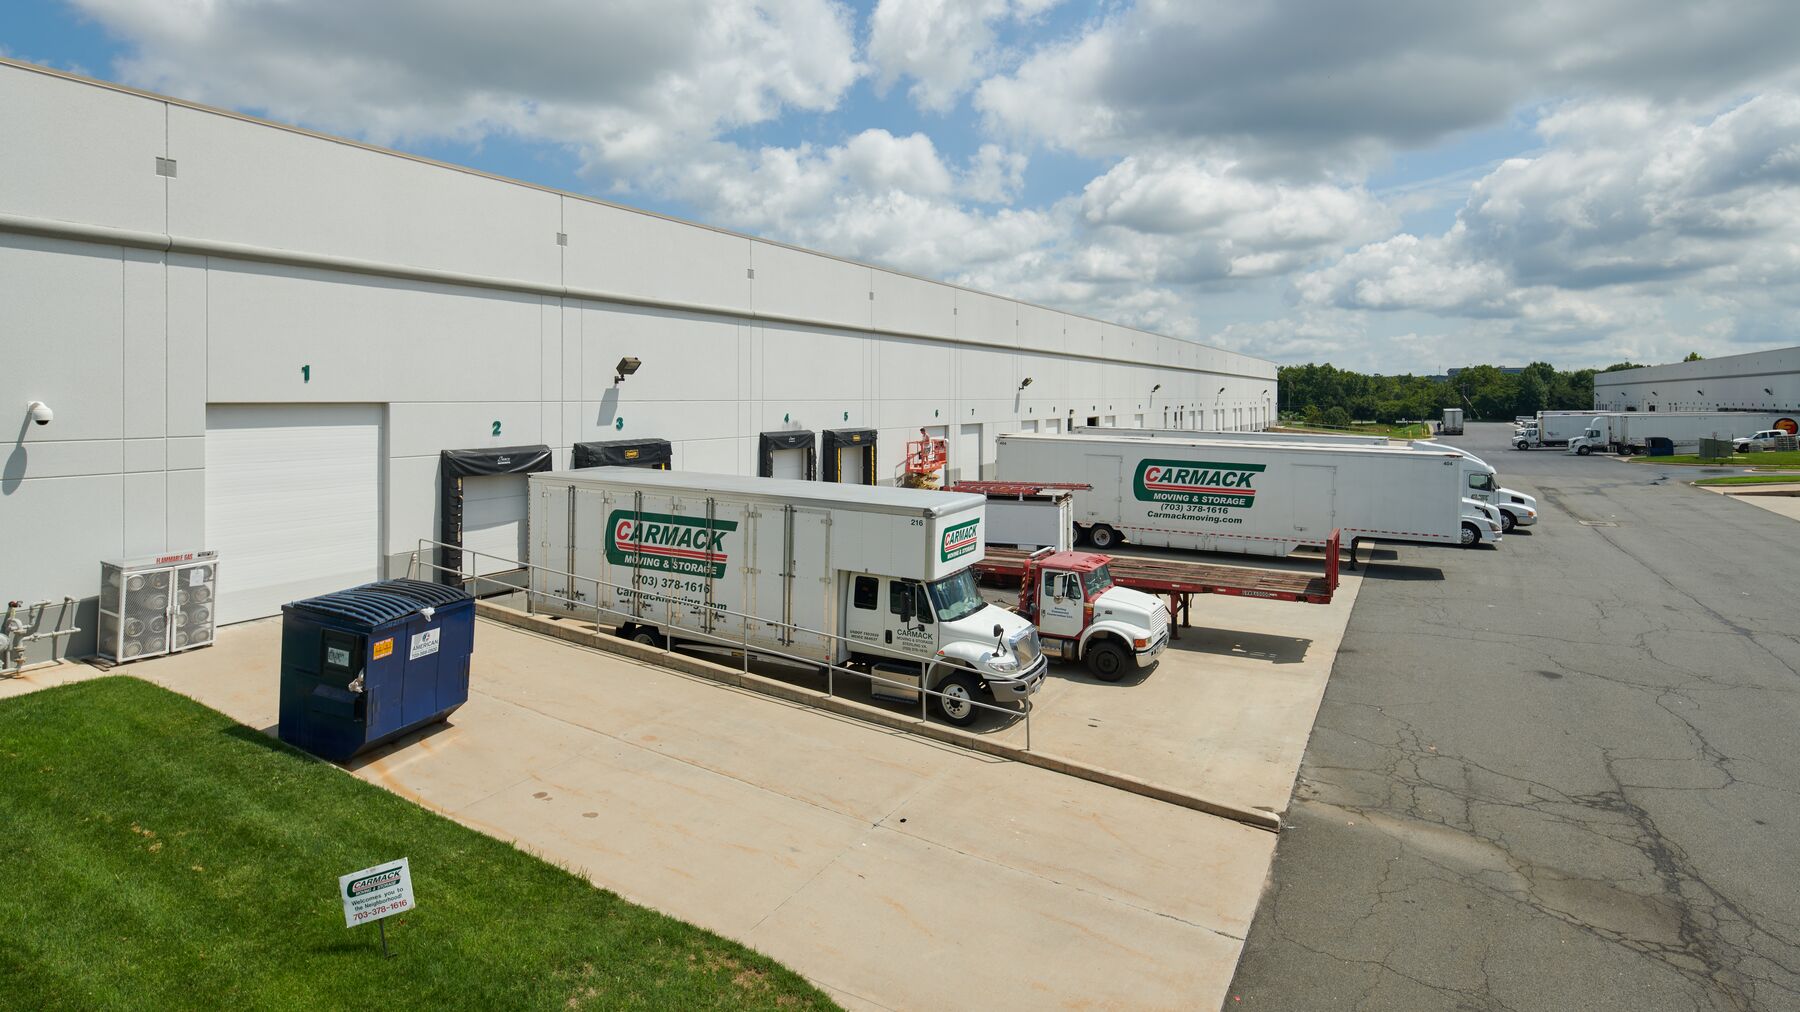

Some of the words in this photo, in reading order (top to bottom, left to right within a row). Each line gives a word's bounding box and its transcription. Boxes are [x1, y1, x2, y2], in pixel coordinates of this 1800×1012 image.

[301, 364, 310, 383] 1
[615, 417, 624, 430] 3
[784, 413, 790, 423] 4
[843, 411, 849, 421] 5
[492, 421, 502, 436] 2
[1145, 467, 1256, 488] CARMACK
[1153, 492, 1190, 502] MOVING
[1192, 495, 1199, 503] &
[1201, 496, 1246, 506] STORAGE
[1160, 503, 1184, 513] (703)
[1186, 505, 1229, 515] 378-1616
[910, 519, 924, 527] 216
[1147, 510, 1242, 524] Carmackmoving.com
[616, 521, 727, 552] CARMACK
[945, 525, 978, 547] CARMACK
[156, 554, 183, 565] FLAMMABLE
[184, 552, 193, 561] GAS
[624, 554, 660, 567] MOVING
[662, 559, 670, 569] &
[672, 560, 718, 575] STORAGE
[632, 574, 658, 588] (703)
[661, 578, 711, 594] 378-1616
[616, 587, 728, 611] Carmackmovingcom
[897, 629, 933, 640] CARMACK
[413, 639, 439, 651] AMERICAN
[354, 870, 401, 889] CARMACK
[351, 895, 382, 906] Welcomes
[384, 890, 395, 898] you
[364, 893, 402, 908] Neighborhood!
[353, 899, 408, 920] 703-378-1616
